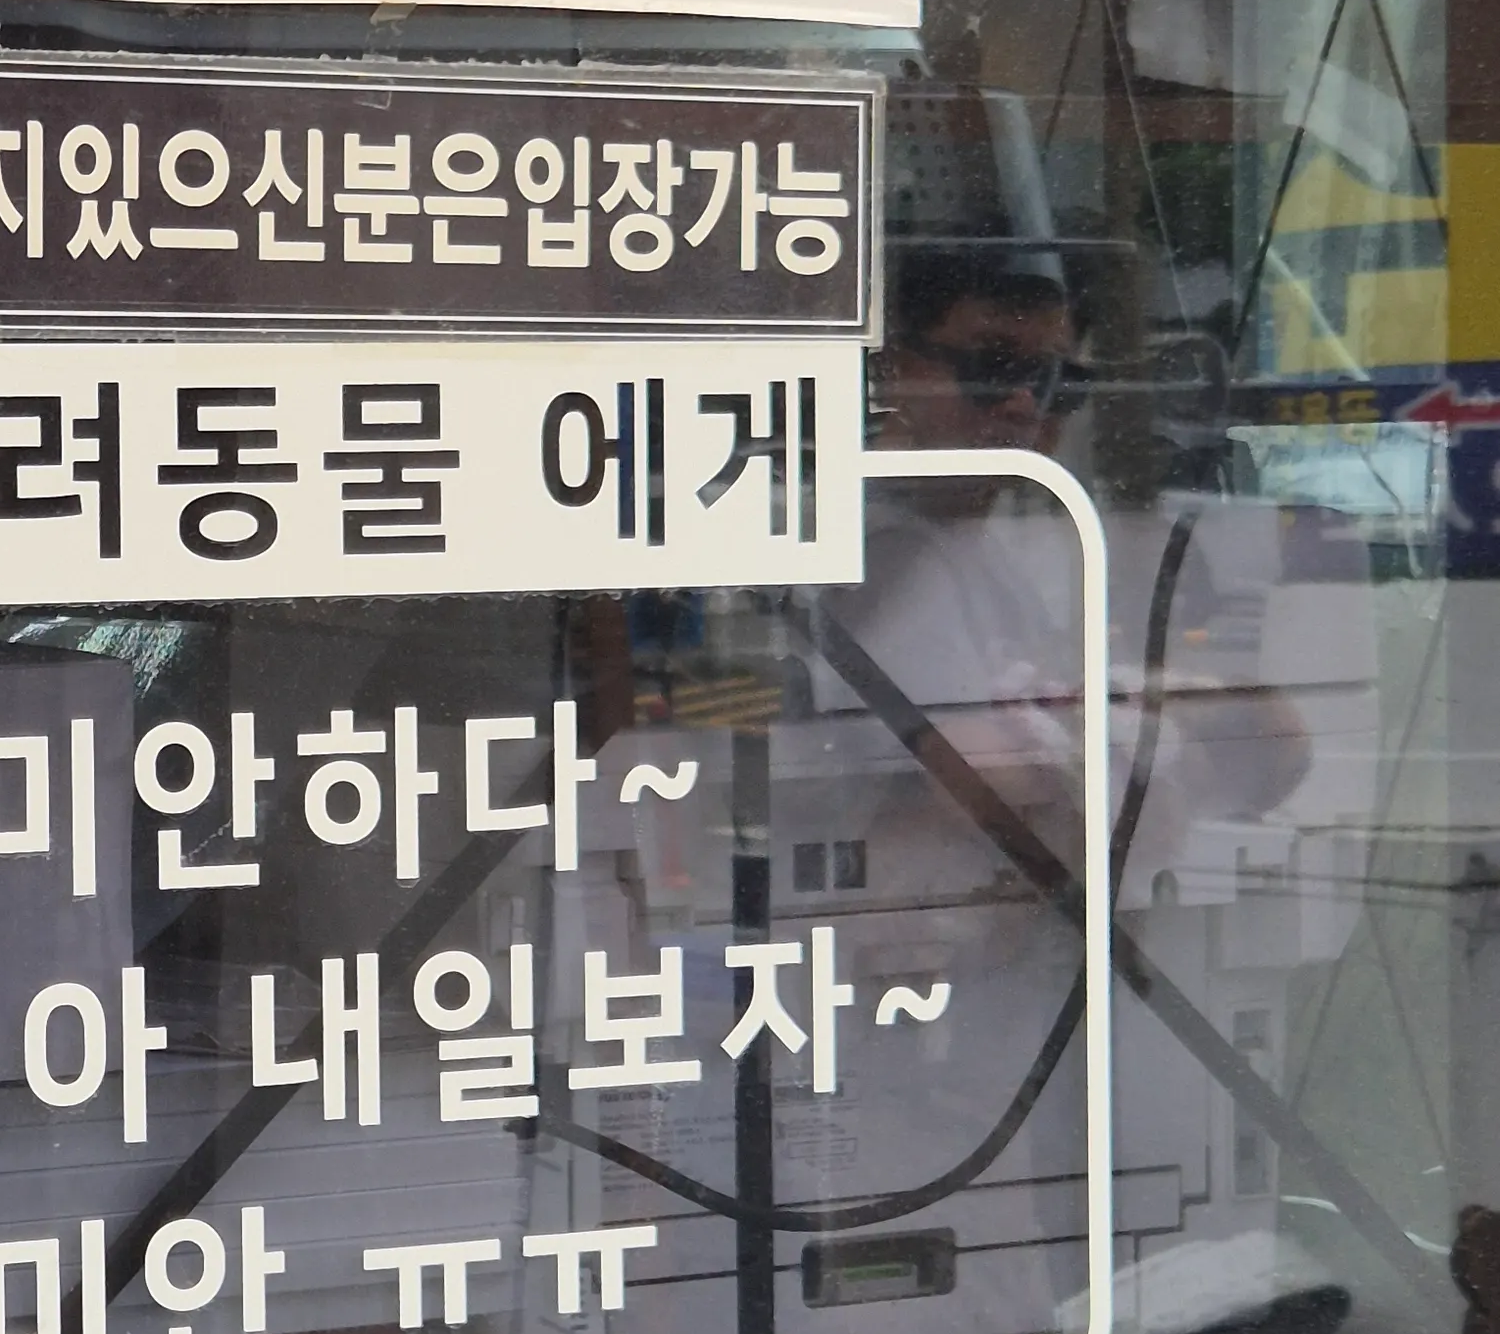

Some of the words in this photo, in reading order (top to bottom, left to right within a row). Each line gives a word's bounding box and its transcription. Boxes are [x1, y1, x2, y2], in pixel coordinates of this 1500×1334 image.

[541, 376, 819, 548] 에게
[251, 926, 955, 1127] 내일보자~
[363, 1224, 659, 1329] ㅠㅠ
